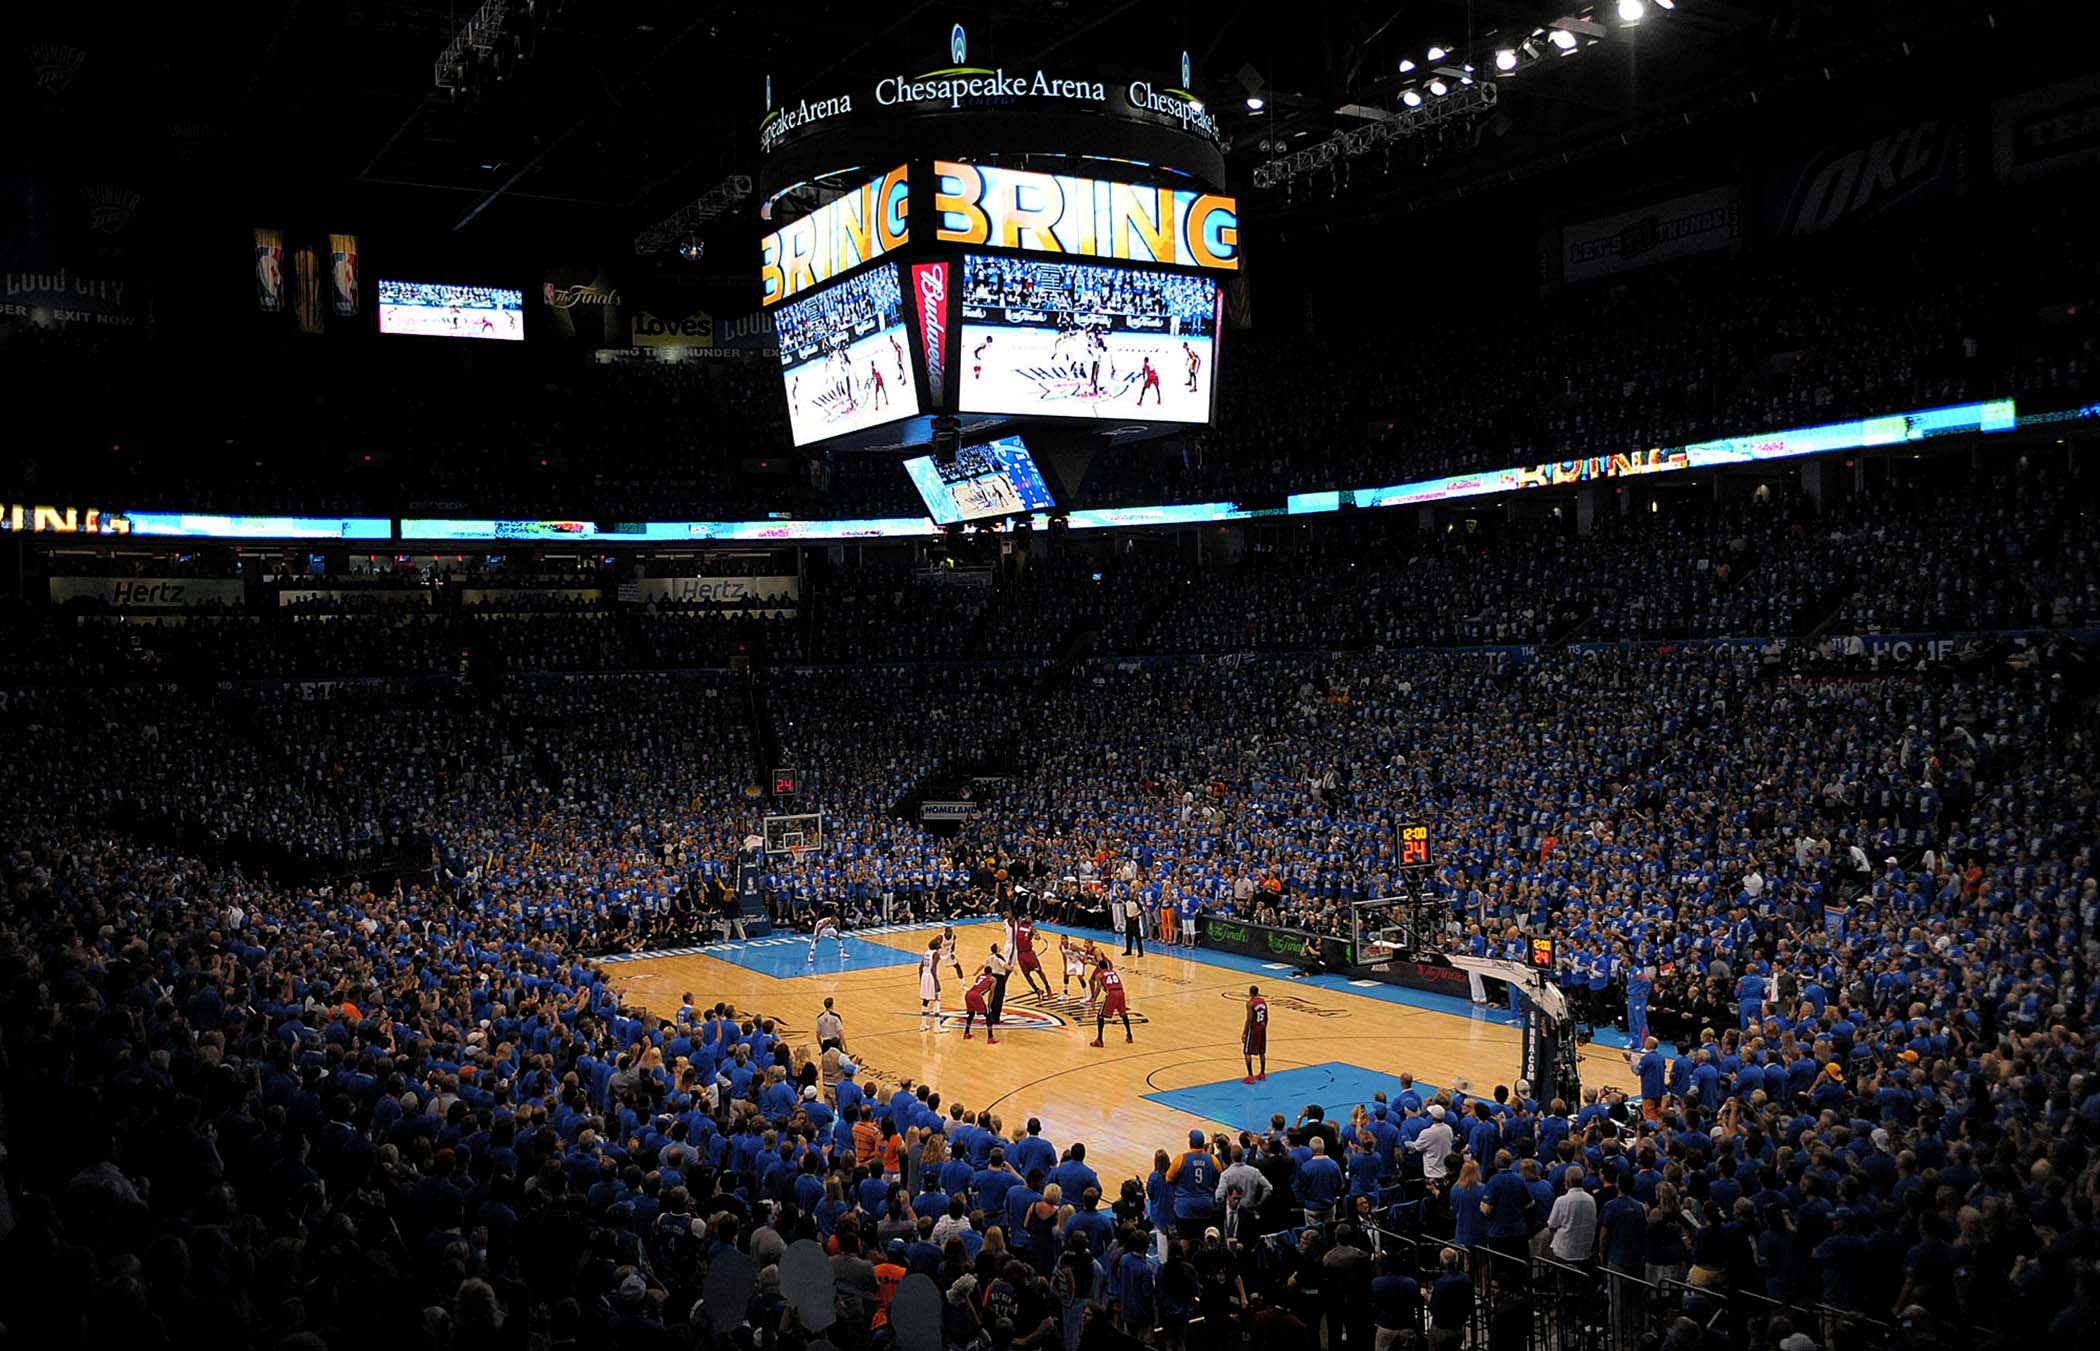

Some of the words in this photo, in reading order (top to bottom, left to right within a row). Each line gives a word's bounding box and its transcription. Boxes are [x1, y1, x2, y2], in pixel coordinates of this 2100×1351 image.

[875, 68, 1027, 108] Chesapeake
[1029, 70, 1106, 101] Arena
[796, 94, 852, 126] Arena
[934, 160, 1239, 270] BRING
[761, 163, 909, 307] BRING
[568, 284, 622, 308] Finals
[54, 309, 92, 322] EXIT
[114, 582, 184, 602] Hertz
[683, 580, 744, 598] Hertz
[775, 778, 794, 793] 24
[925, 805, 978, 815] HOMELAND
[1403, 827, 1427, 840] 12:00
[1403, 841, 1427, 863] 24
[1106, 975, 1119, 984] 40
[1256, 1010, 1265, 1022] 15
[1194, 1168, 1203, 1183] 9
